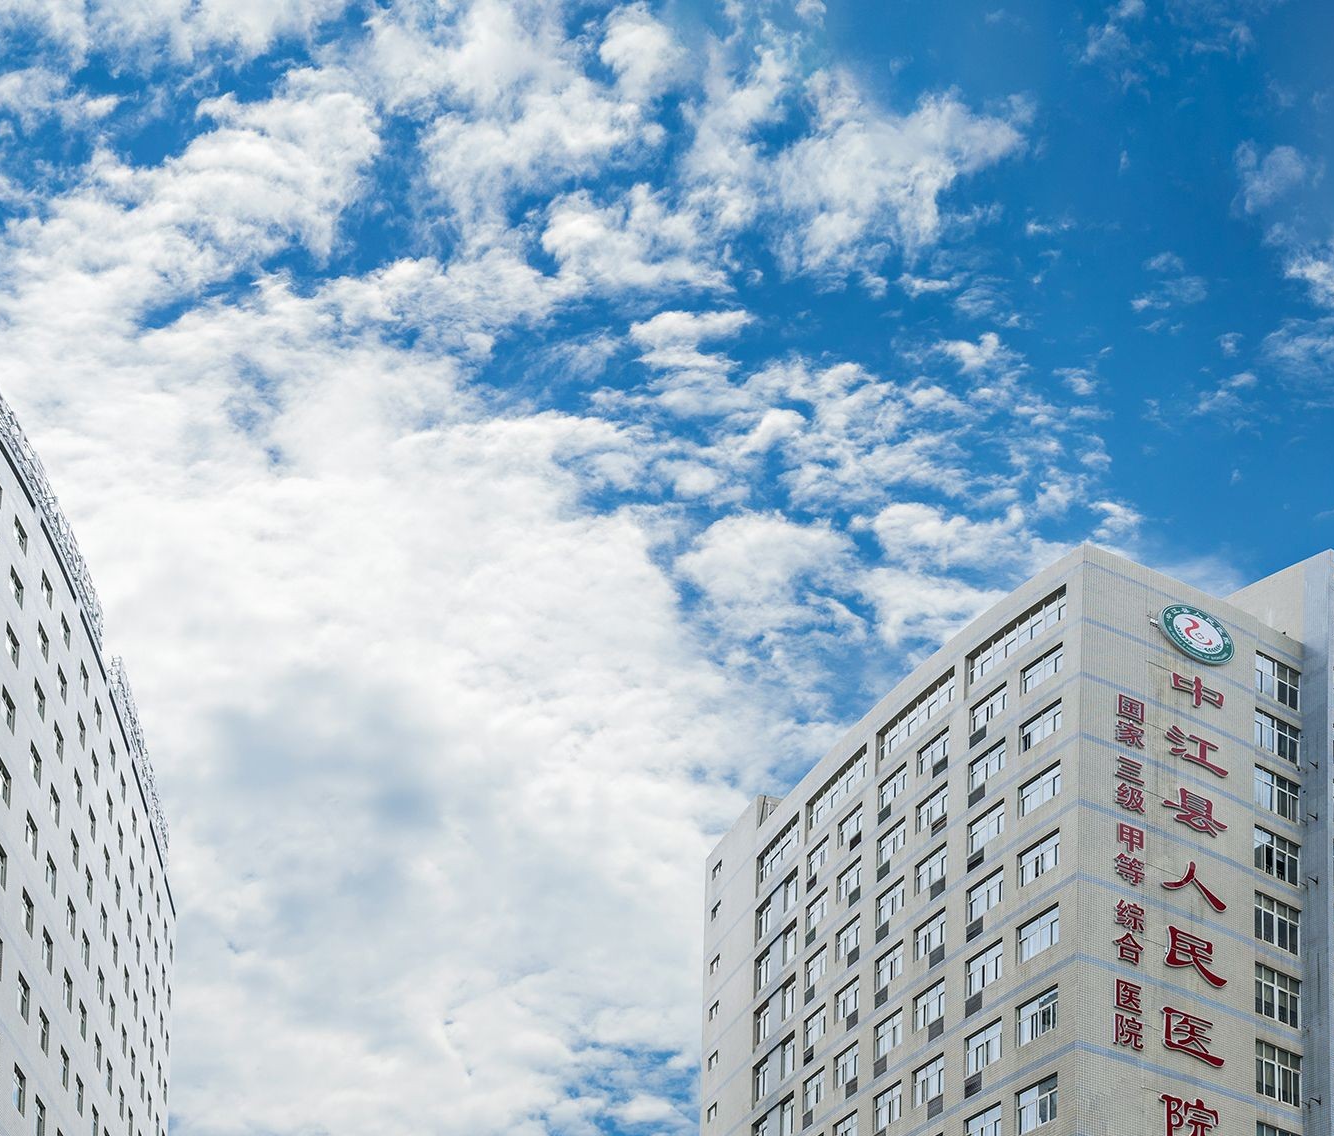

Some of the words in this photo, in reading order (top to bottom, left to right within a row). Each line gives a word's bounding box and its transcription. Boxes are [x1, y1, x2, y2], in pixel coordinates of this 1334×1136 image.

[1114, 693, 1146, 1051] 国家三级甲等综合医院
